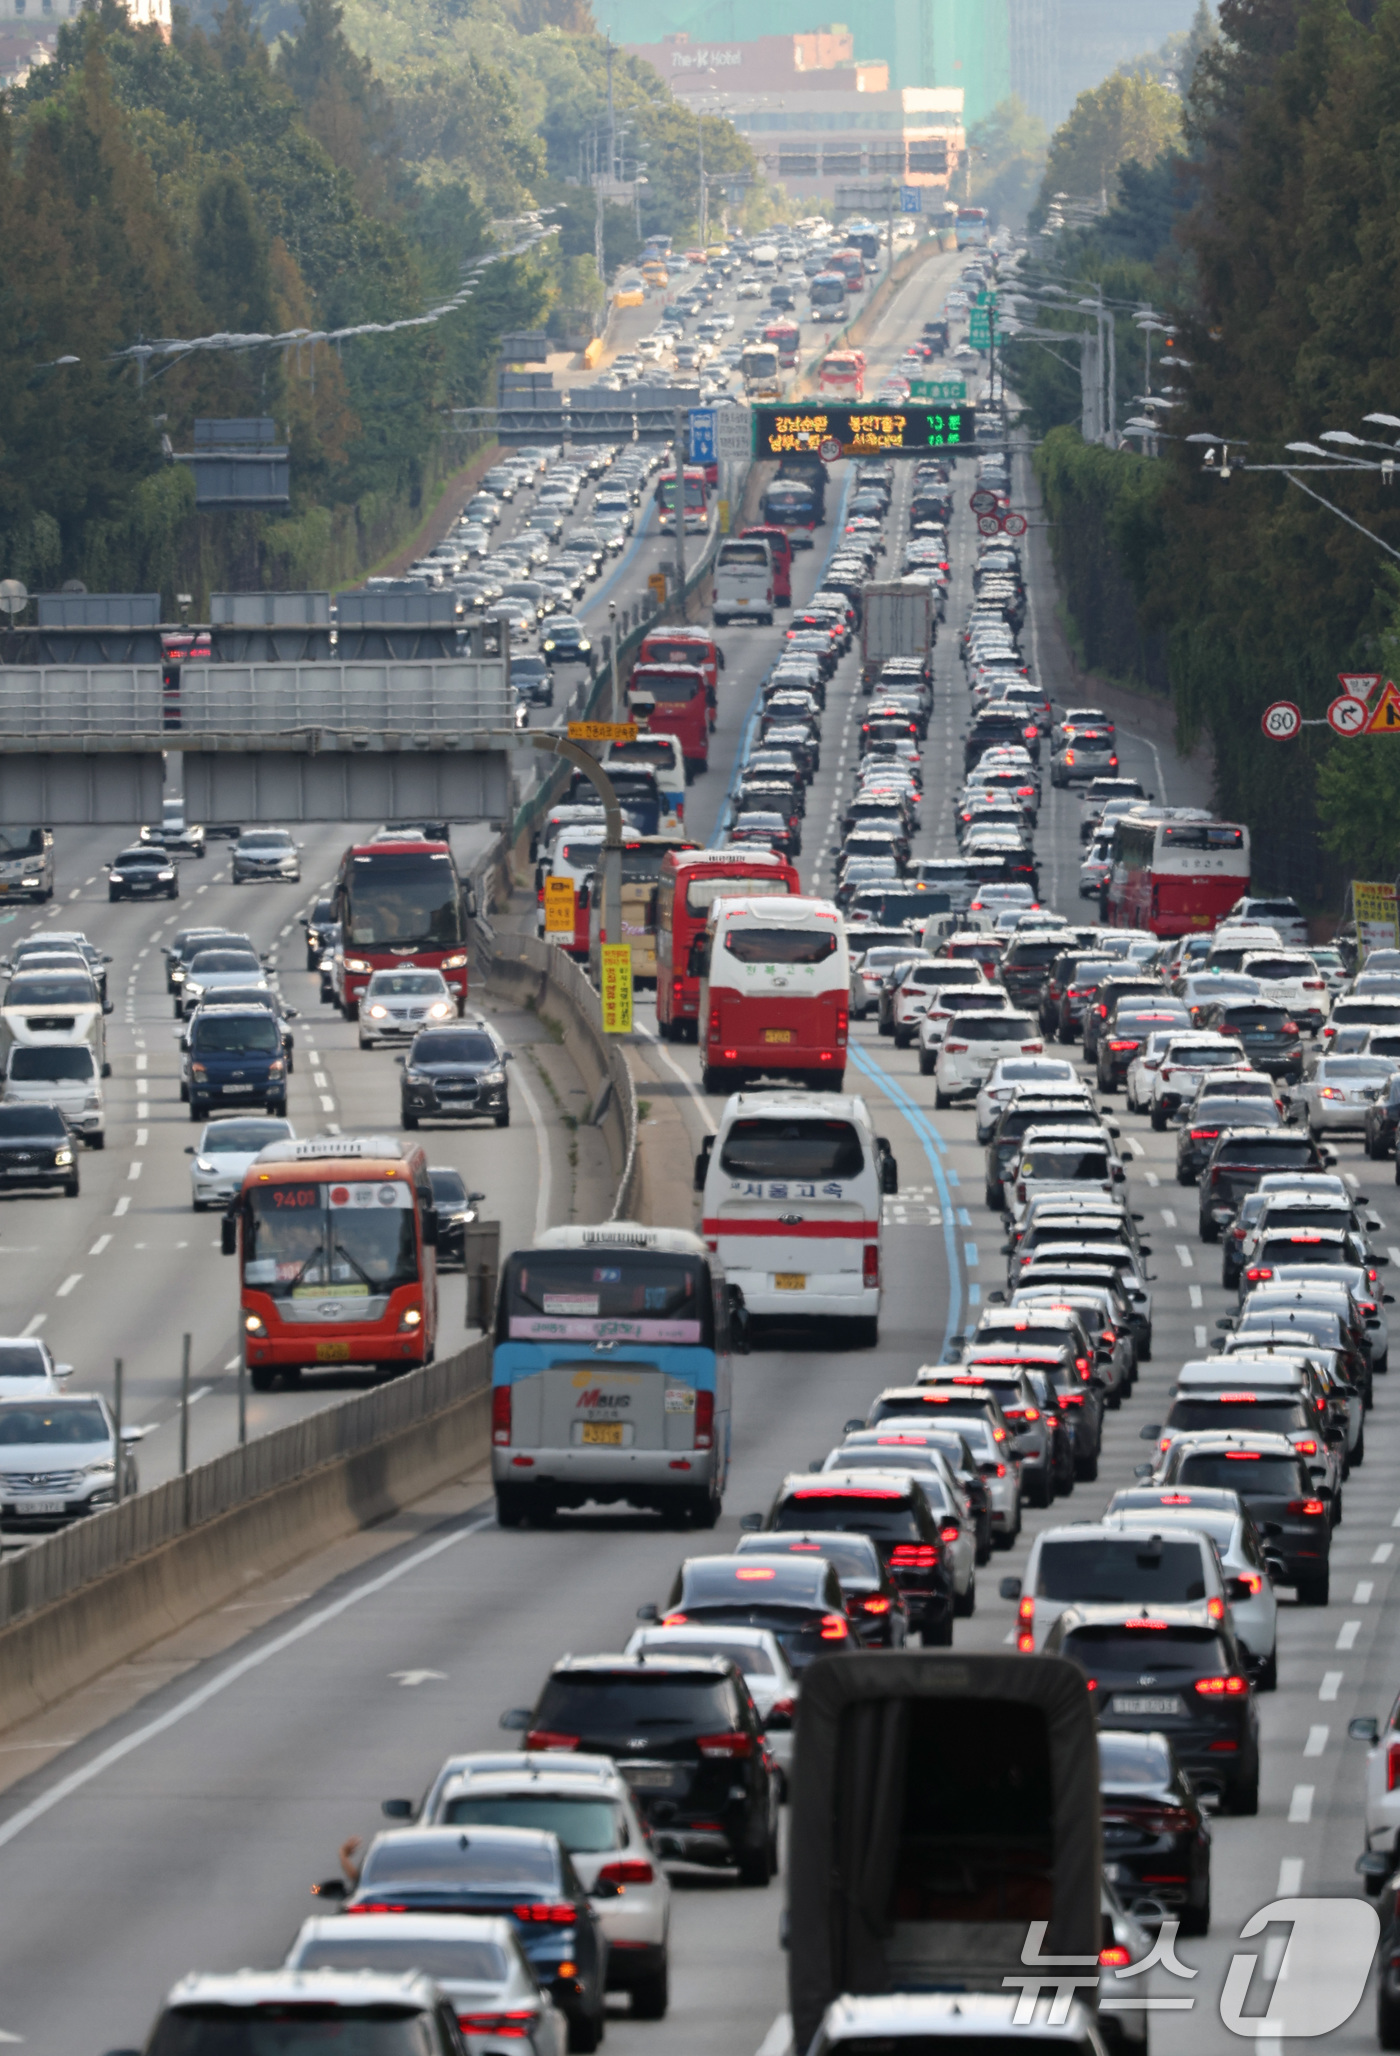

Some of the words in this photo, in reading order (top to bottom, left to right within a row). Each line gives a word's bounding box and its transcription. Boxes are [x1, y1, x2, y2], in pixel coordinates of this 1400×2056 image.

[711, 49, 742, 66] Hotel
[775, 415, 828, 433] 강남순환
[849, 415, 907, 433] 봉천T출구
[1270, 712, 1293, 730] 80
[272, 1189, 317, 1208] 9401
